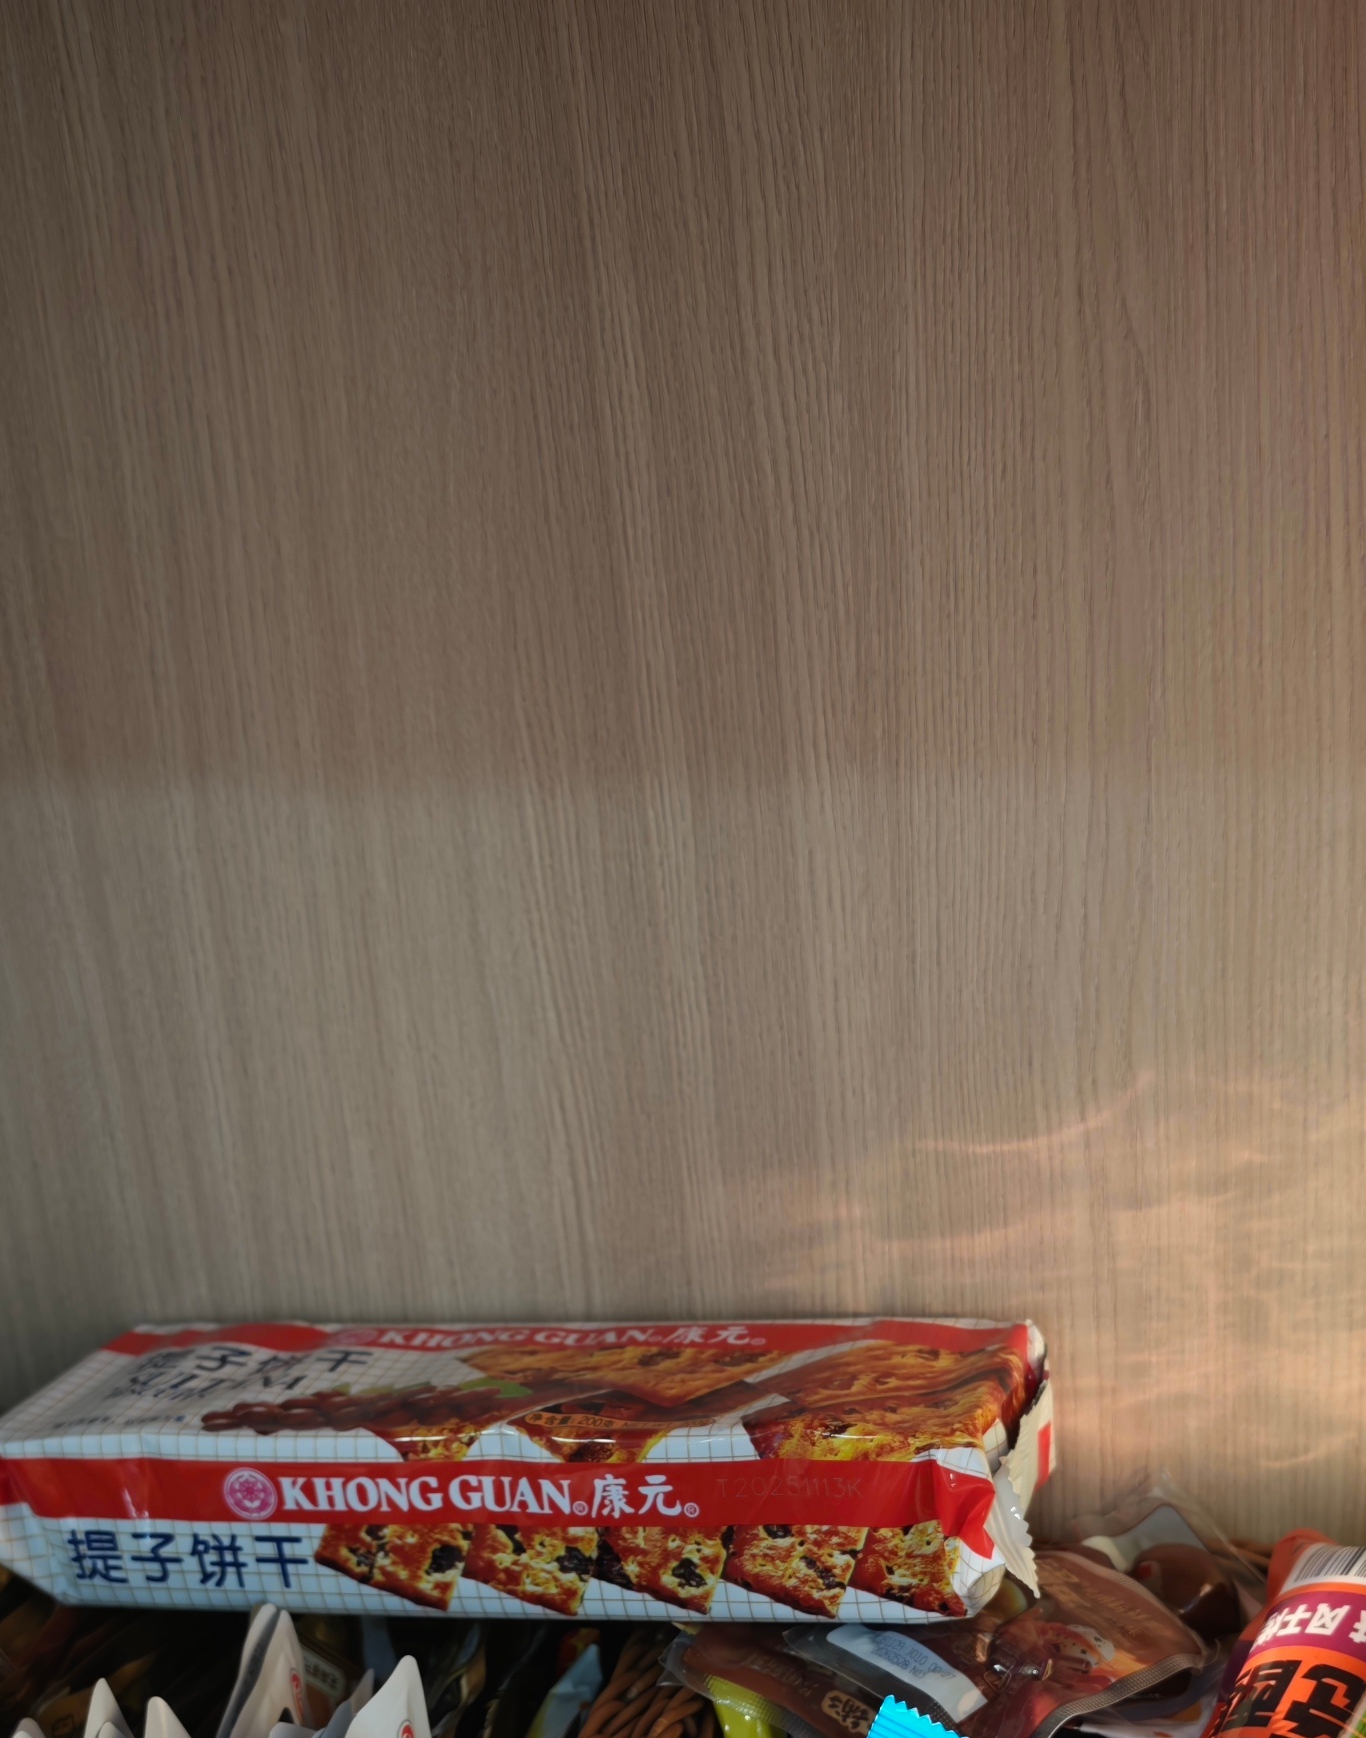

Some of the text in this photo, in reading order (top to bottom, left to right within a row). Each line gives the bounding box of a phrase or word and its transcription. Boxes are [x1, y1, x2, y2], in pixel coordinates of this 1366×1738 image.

[379, 1326, 749, 1347] KHONG GUAN 康元
[279, 1473, 684, 1518] KHONG GUAN 康元
[67, 1527, 309, 1590] 提子饼干
[823, 1693, 874, 1736] 铺子
